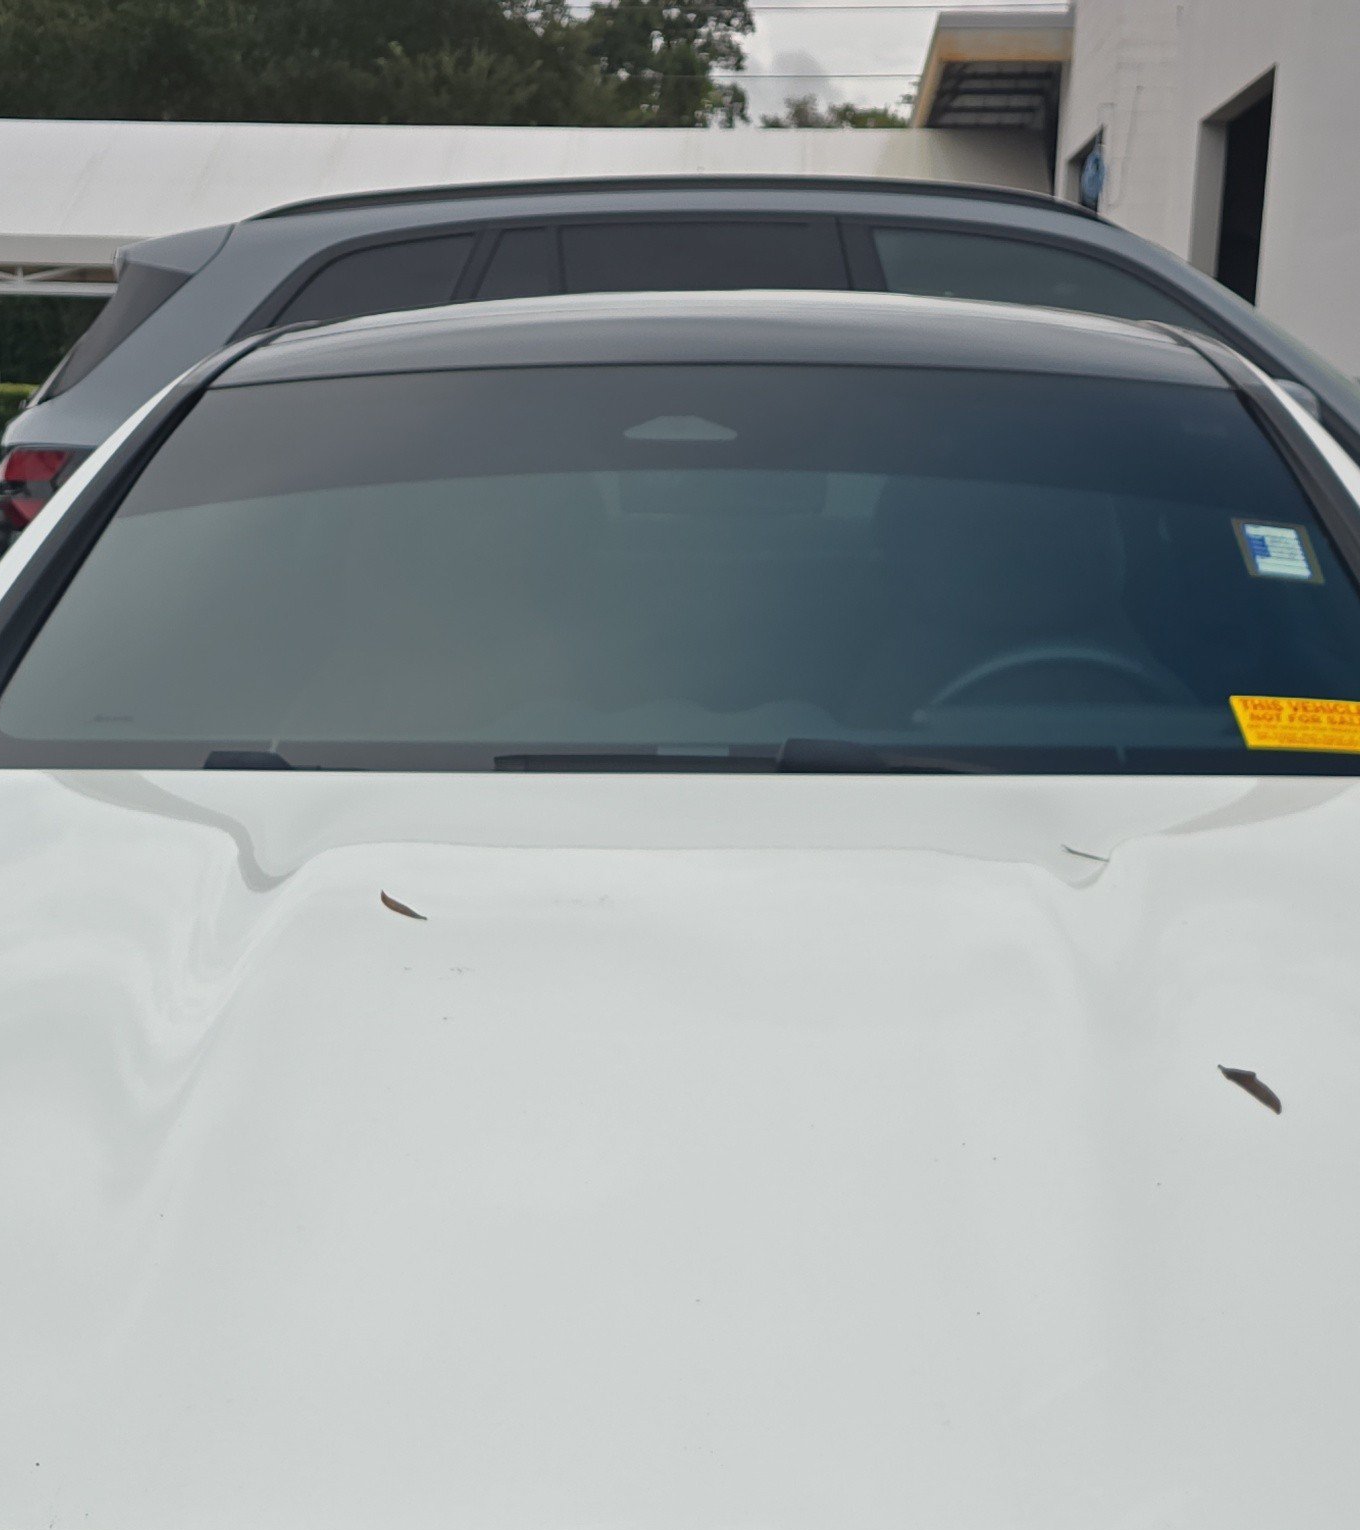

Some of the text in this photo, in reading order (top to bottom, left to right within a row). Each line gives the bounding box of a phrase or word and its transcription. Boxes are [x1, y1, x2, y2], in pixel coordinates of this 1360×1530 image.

[1239, 698, 1284, 713] THIS
[1249, 712, 1282, 723] NOT
[1288, 713, 1322, 724] FOR
